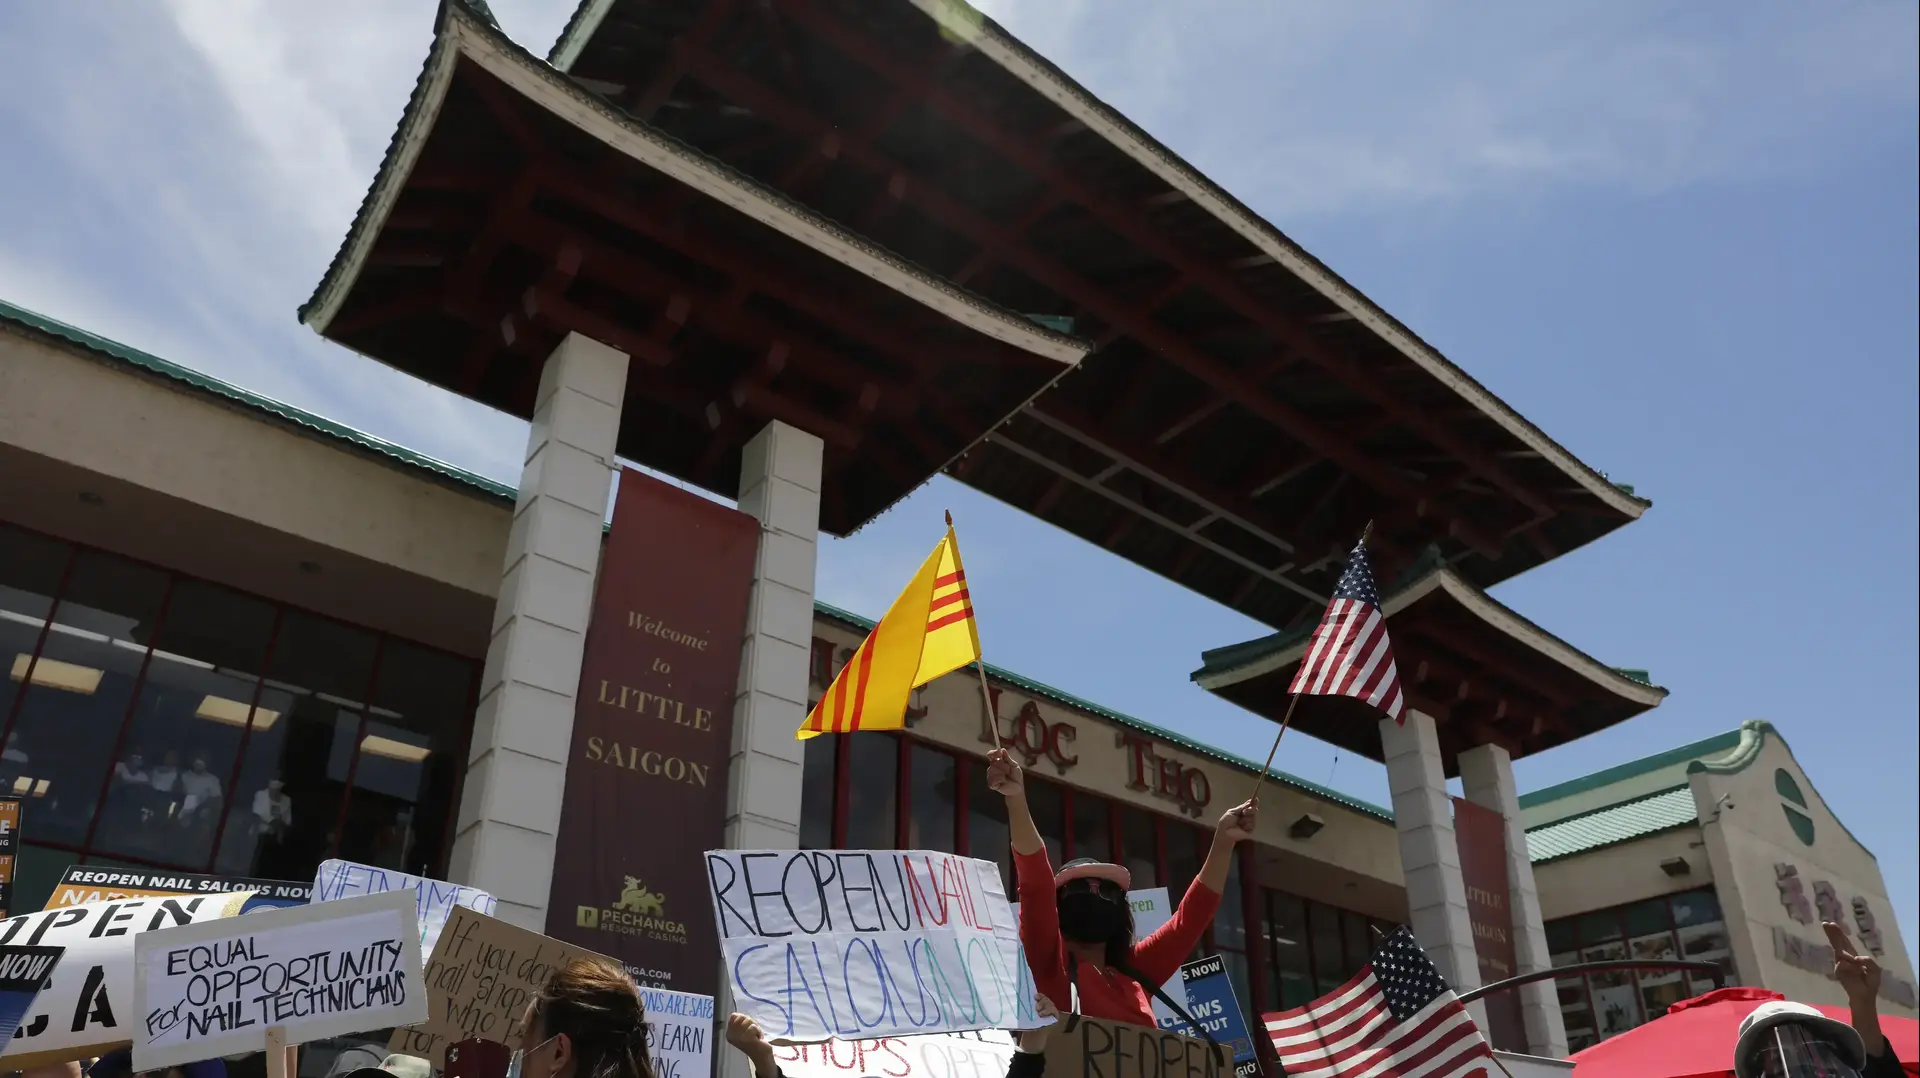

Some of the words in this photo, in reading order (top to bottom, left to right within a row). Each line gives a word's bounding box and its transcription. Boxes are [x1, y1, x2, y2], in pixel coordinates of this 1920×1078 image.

[628, 611, 709, 651] Welcome
[652, 657, 671, 674] to
[598, 679, 712, 732] LITTLE
[585, 736, 711, 788] SAIGON
[69, 870, 146, 886] REOPEN
[149, 876, 194, 890] NAIL
[198, 880, 271, 896] SALONS
[707, 852, 911, 938] REOPEN
[902, 854, 993, 932] NAIL
[1466, 885, 1503, 909] ITTLE
[602, 909, 687, 935] PECHANGA
[1130, 899, 1156, 913] ren
[601, 922, 642, 936] RESORT
[167, 936, 269, 977] EQUAL
[445, 915, 480, 959] If
[472, 941, 516, 979] you
[0, 953, 54, 980] NOW
[186, 939, 403, 1006] OPPORTUNITY
[424, 959, 472, 996] nail
[621, 965, 672, 980] NGA.COM
[1191, 961, 1221, 978] NOW
[734, 937, 941, 1038] SALONS
[186, 1000, 256, 1040] NAIL
[253, 970, 406, 1025] TECHNICIANS
[1160, 999, 1223, 1029] CLWS
[661, 1022, 705, 1054] EARN
